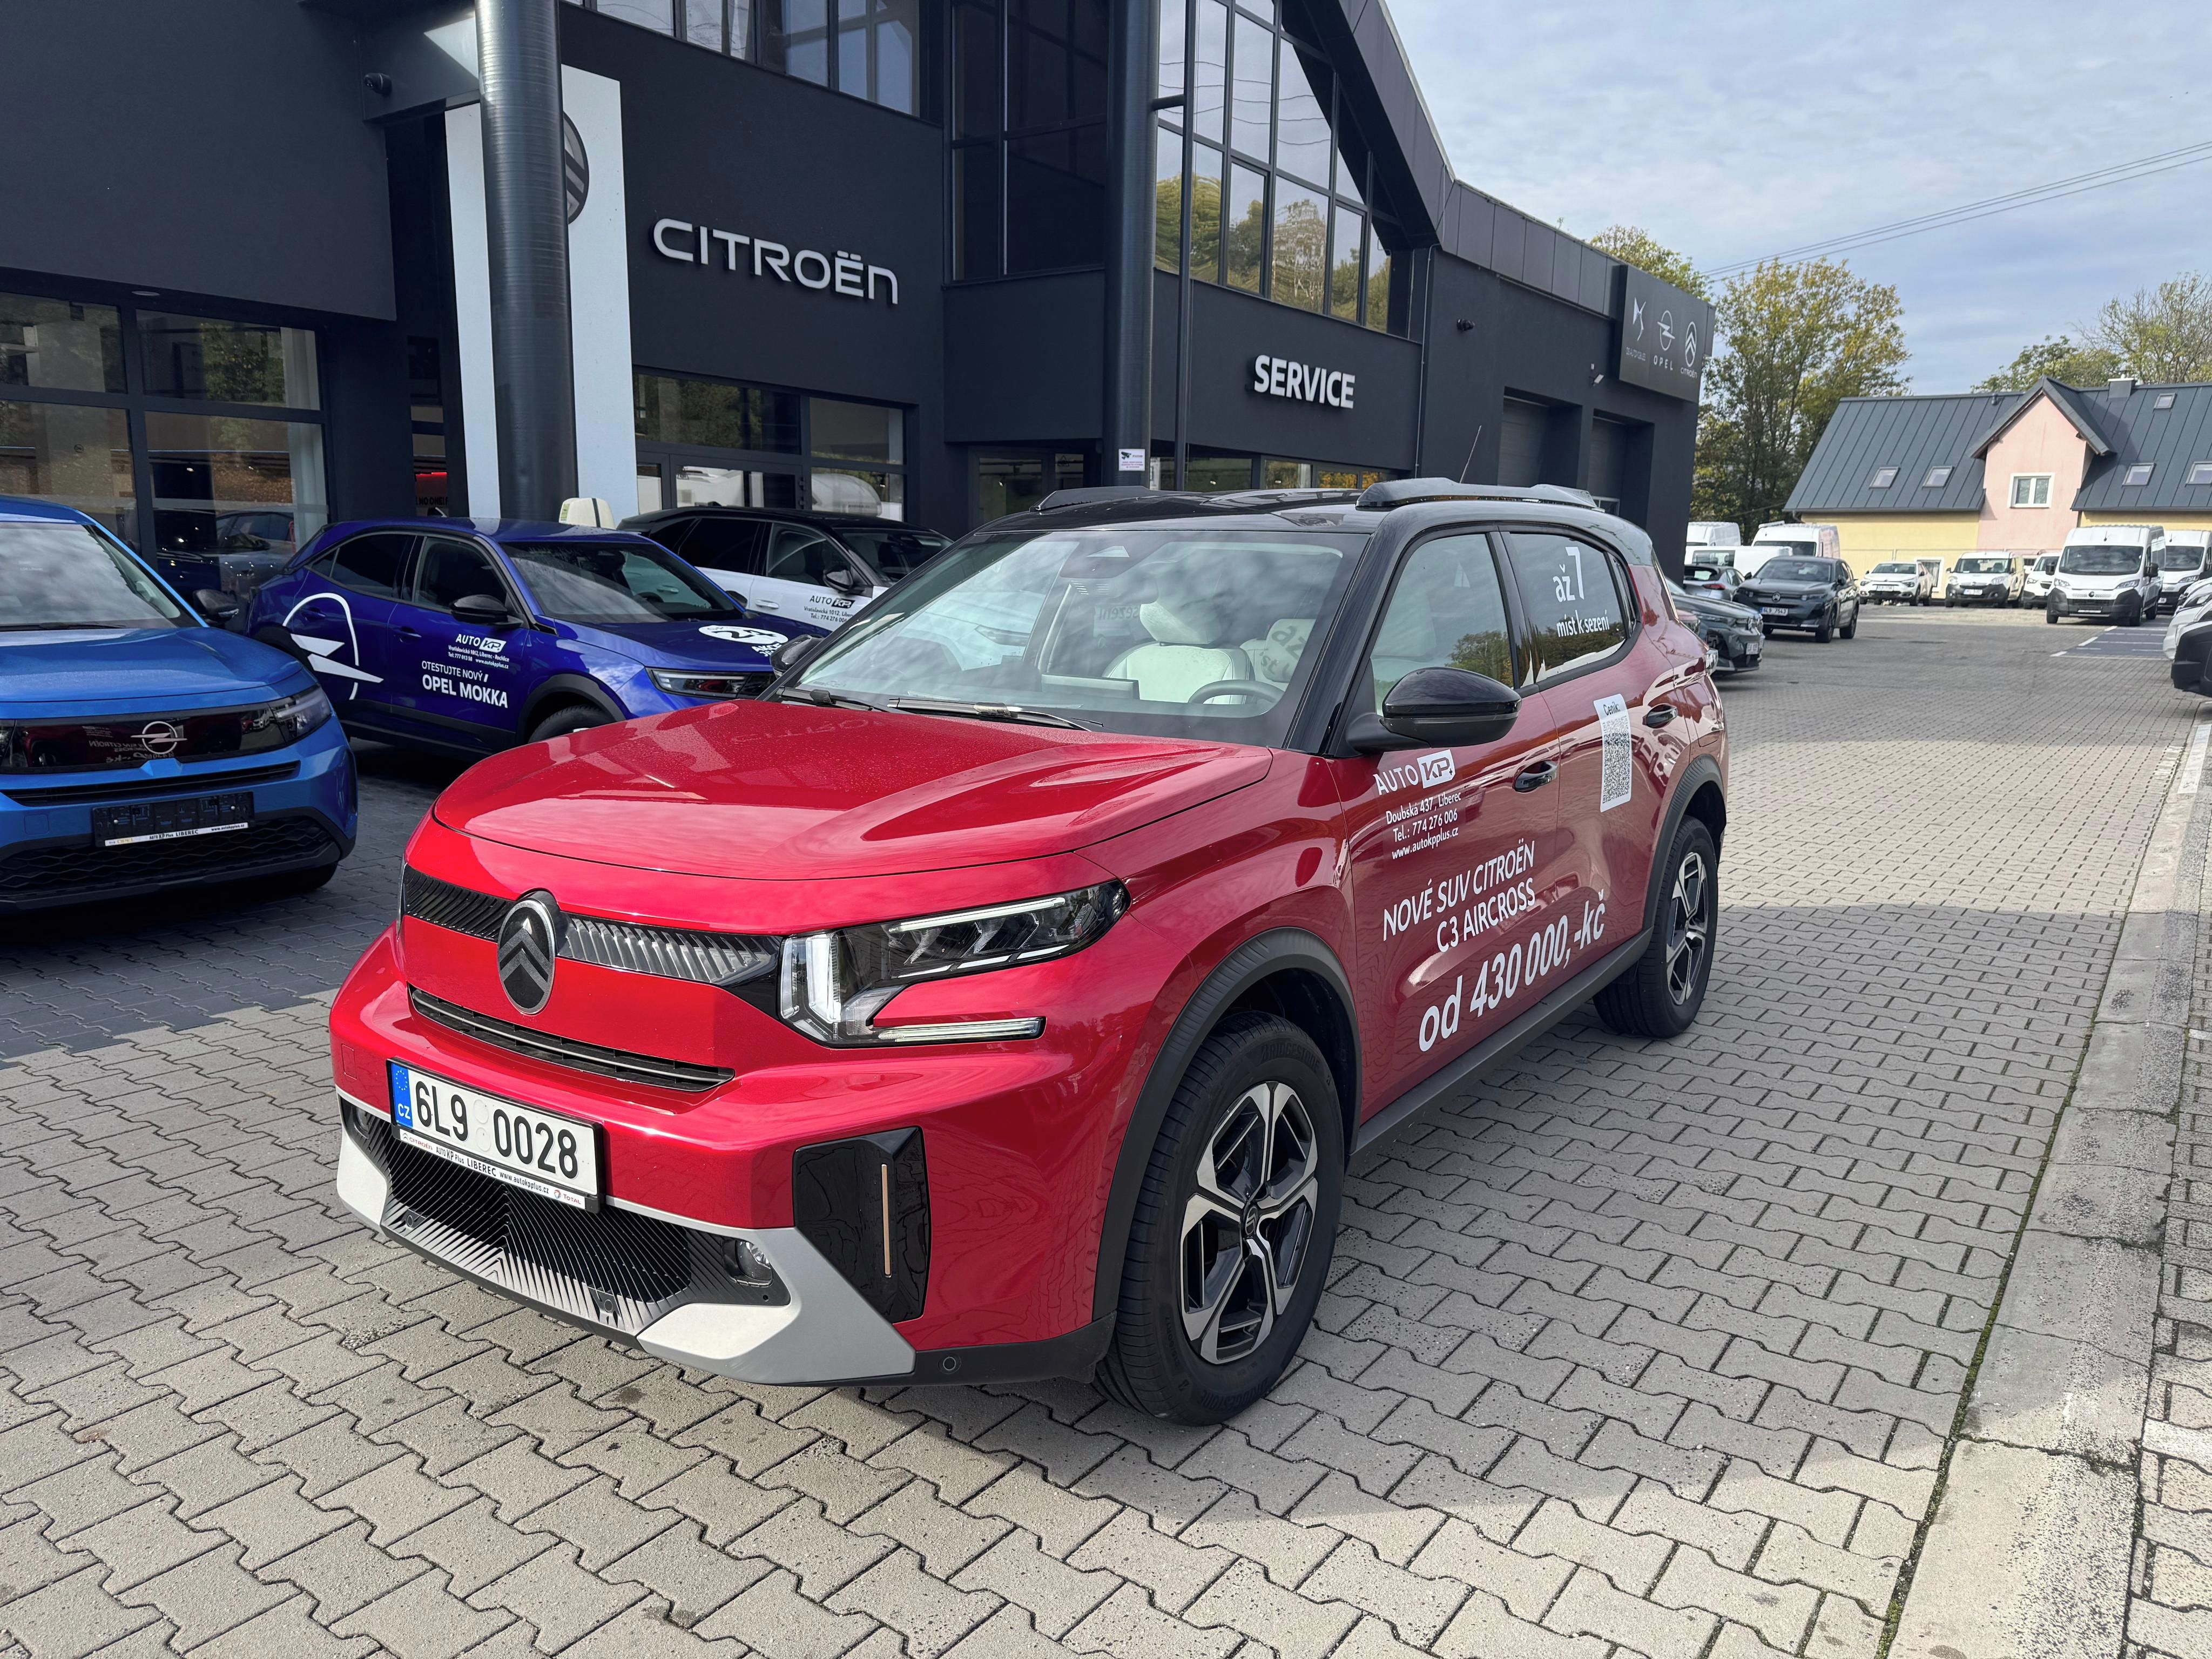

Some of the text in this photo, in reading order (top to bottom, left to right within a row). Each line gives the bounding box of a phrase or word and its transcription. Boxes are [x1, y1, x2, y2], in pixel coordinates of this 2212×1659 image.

[653, 217, 898, 305] CITROËN
[1654, 355, 1673, 371] OPEL
[1253, 354, 1356, 409] SERVICE
[1553, 546, 1584, 603] až 7
[810, 595, 833, 605] AUTO
[455, 633, 481, 646] AUTO
[1556, 609, 1610, 638] míst k sezení
[422, 660, 483, 681] OTESTUJTE NOVÝ
[422, 674, 508, 709] OPEL MOKKA
[1373, 765, 1419, 795] AUTO
[1386, 801, 1419, 825] Doubská
[1438, 792, 1461, 808] Liberec
[1393, 808, 1458, 842] Tel.: 774 276 006
[1392, 827, 1459, 860] www.autokpplus.cz
[1383, 838, 1535, 942] NOVÉ SUV CITROËN
[1437, 877, 1536, 953] C3 AIRCROSS
[1419, 975, 1463, 1052] od
[1469, 943, 1522, 1018] 430
[397, 1103, 411, 1120] CZ
[415, 1081, 578, 1179] 6L9 0028
[436, 1146, 446, 1156] AUTO
[447, 1148, 454, 1161] KP
[455, 1154, 464, 1164] Plus
[467, 1158, 497, 1177] LIBEREC
[500, 1171, 549, 1194] www.autokpplus.cz
